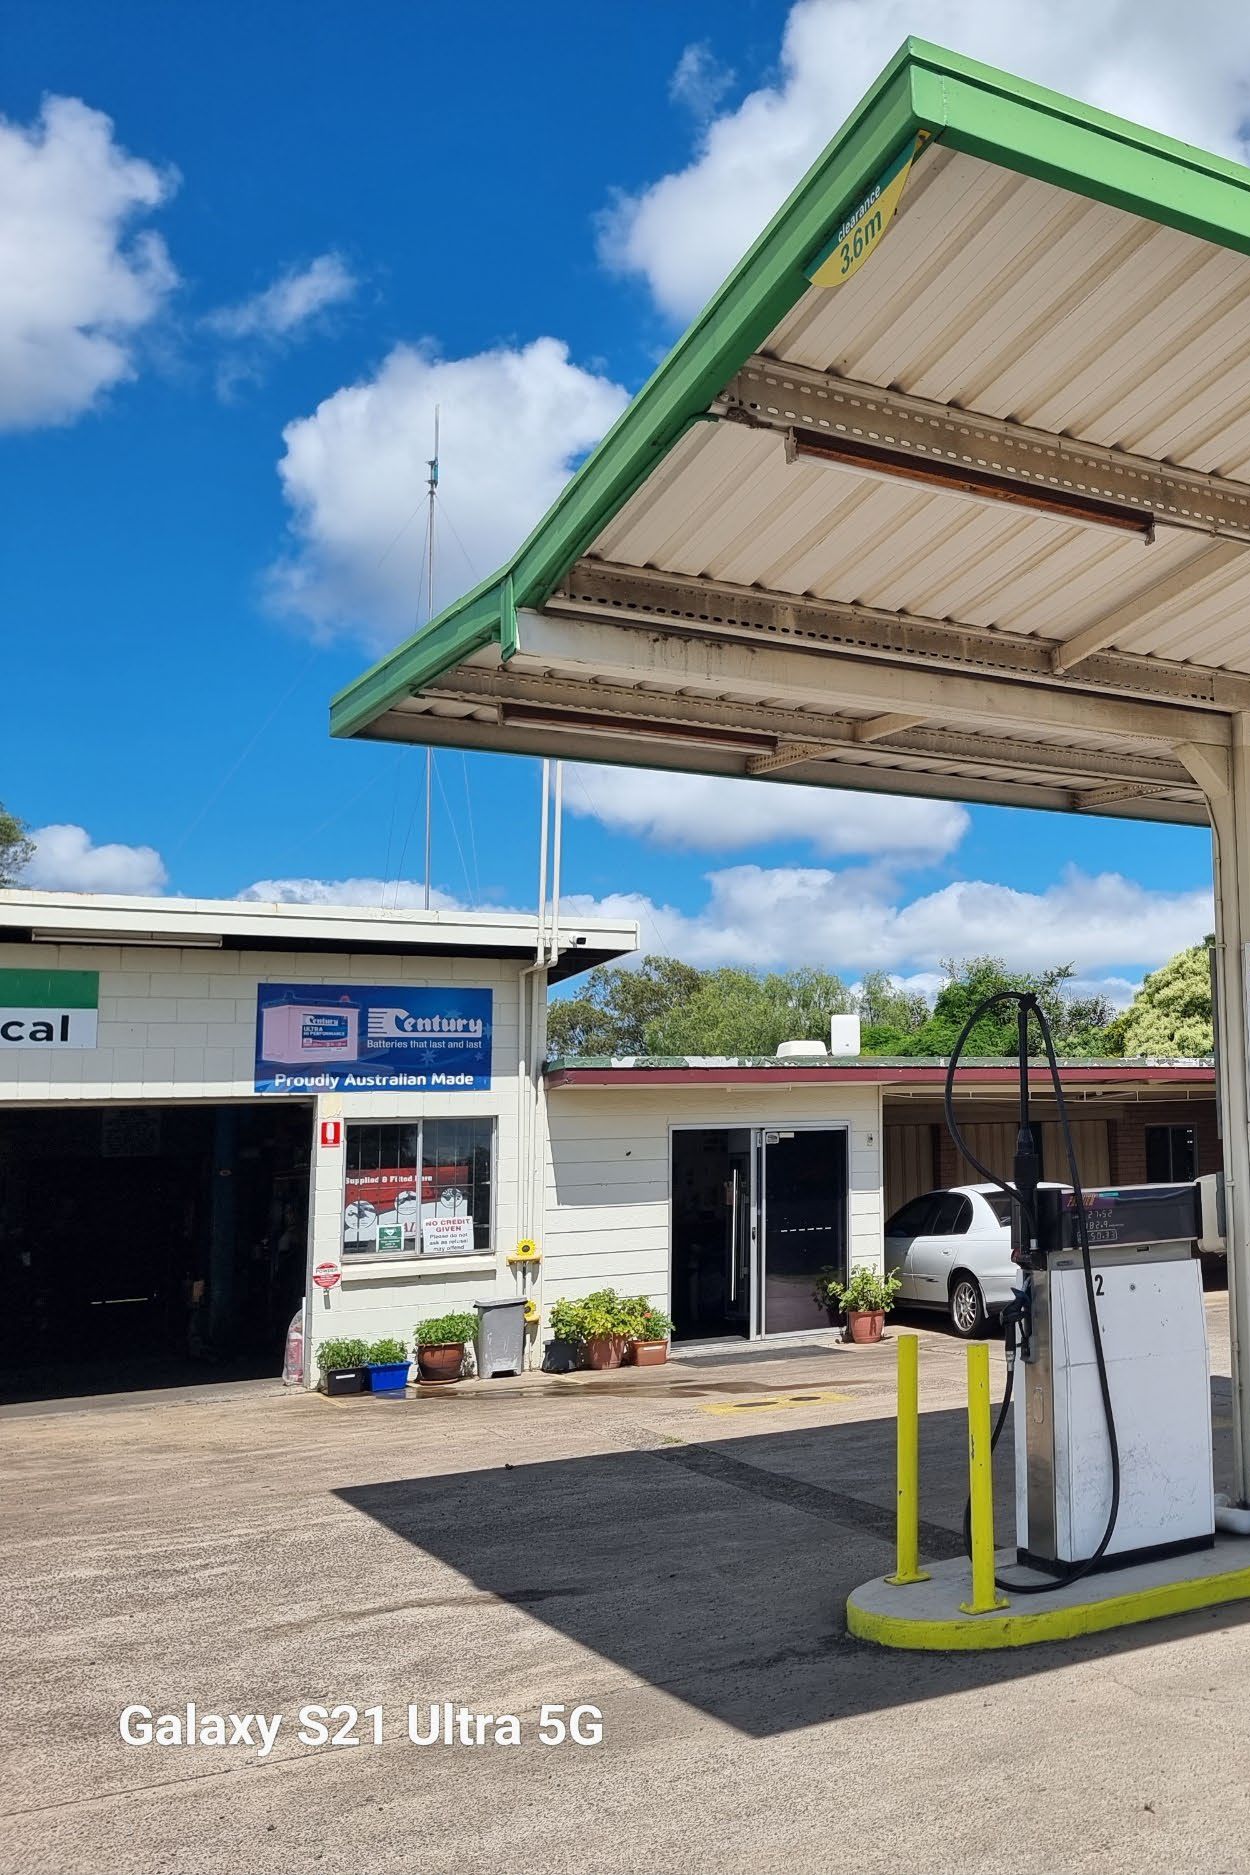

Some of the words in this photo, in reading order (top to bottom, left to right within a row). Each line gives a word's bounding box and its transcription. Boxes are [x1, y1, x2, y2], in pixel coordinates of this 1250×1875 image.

[838, 185, 881, 243] clearance
[840, 210, 883, 274] 3.6m
[0, 1014, 70, 1042] cal
[367, 1007, 483, 1038] Century
[367, 1039, 408, 1049] Batteries
[409, 1039, 428, 1049] that
[429, 1039, 446, 1049] last
[447, 1039, 465, 1049] and
[466, 1039, 483, 1049] last
[274, 1073, 339, 1089] Proudly
[344, 1072, 427, 1087] Australian
[431, 1072, 474, 1086] Made
[440, 1218, 470, 1226] CREDIT
[1094, 1274, 1105, 1297] 2
